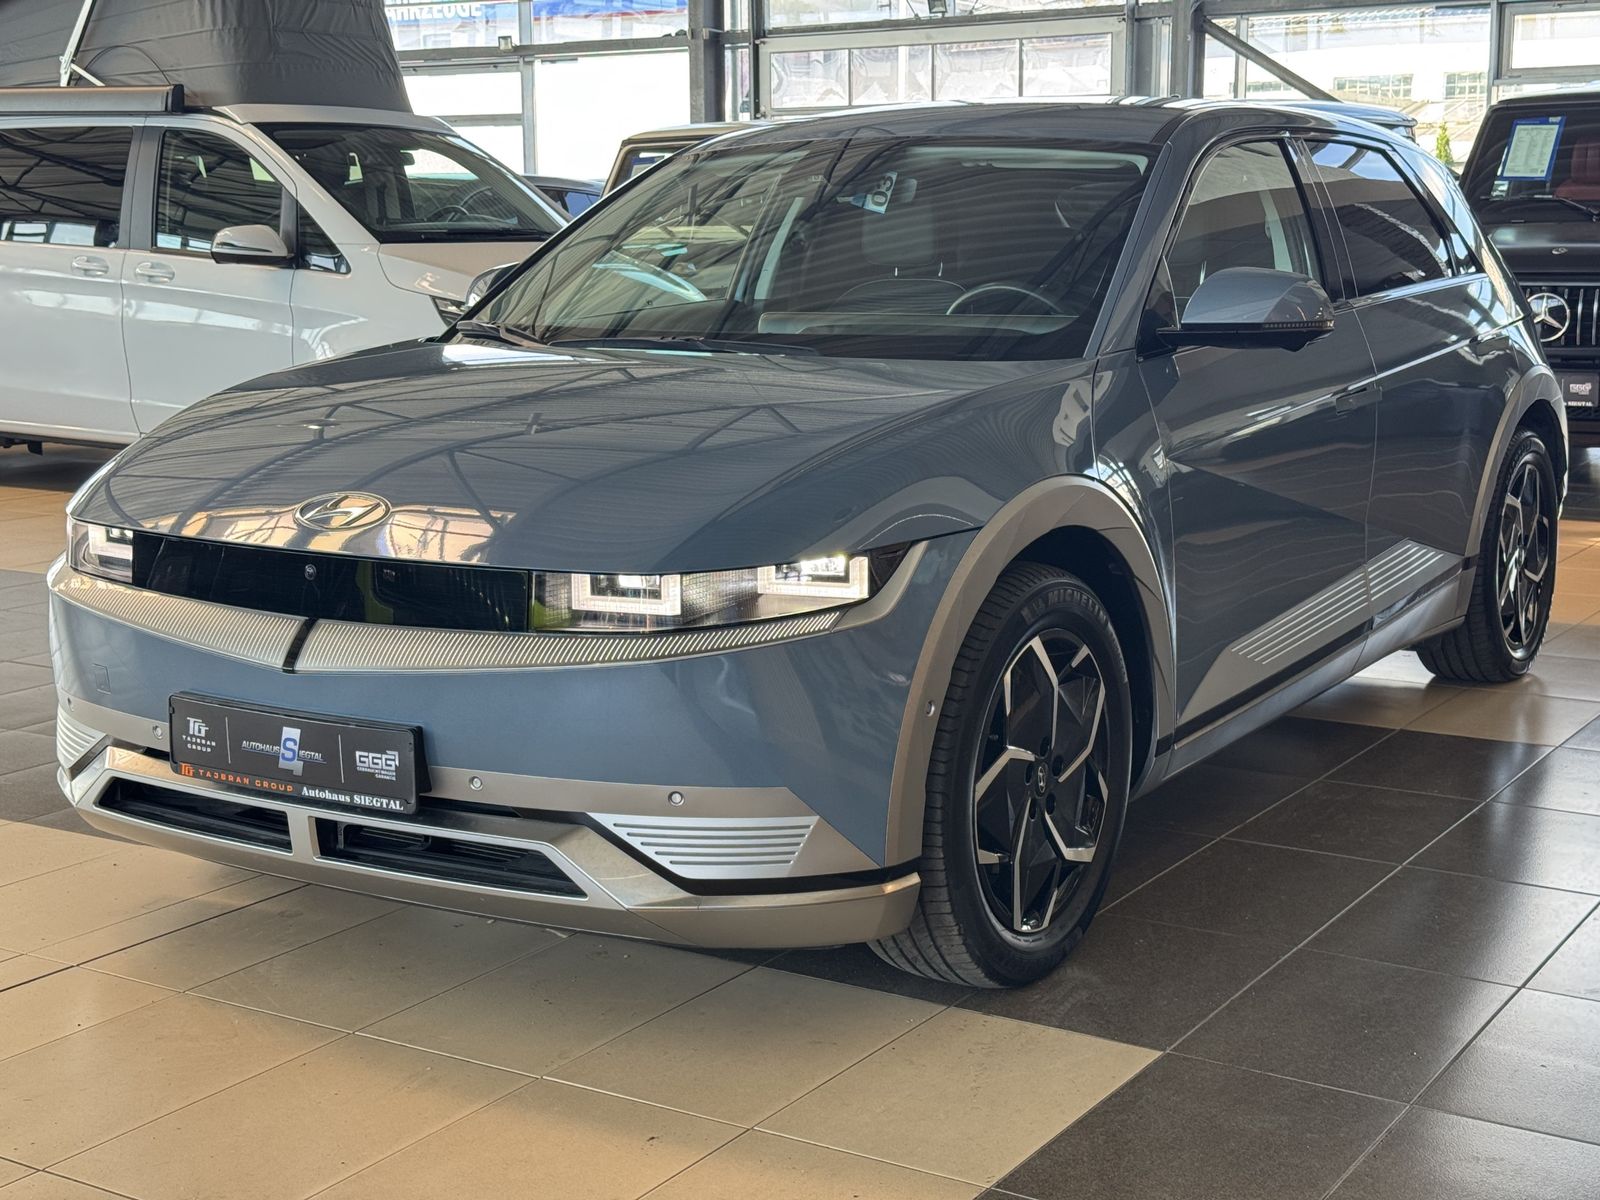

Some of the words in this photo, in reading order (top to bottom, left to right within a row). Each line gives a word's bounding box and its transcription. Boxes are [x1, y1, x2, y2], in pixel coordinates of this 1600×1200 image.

[241, 740, 280, 753] AUTOHAUS
[355, 750, 399, 771] GGG
[302, 786, 351, 802] Autohaus
[353, 794, 404, 811] SIEGTAL
